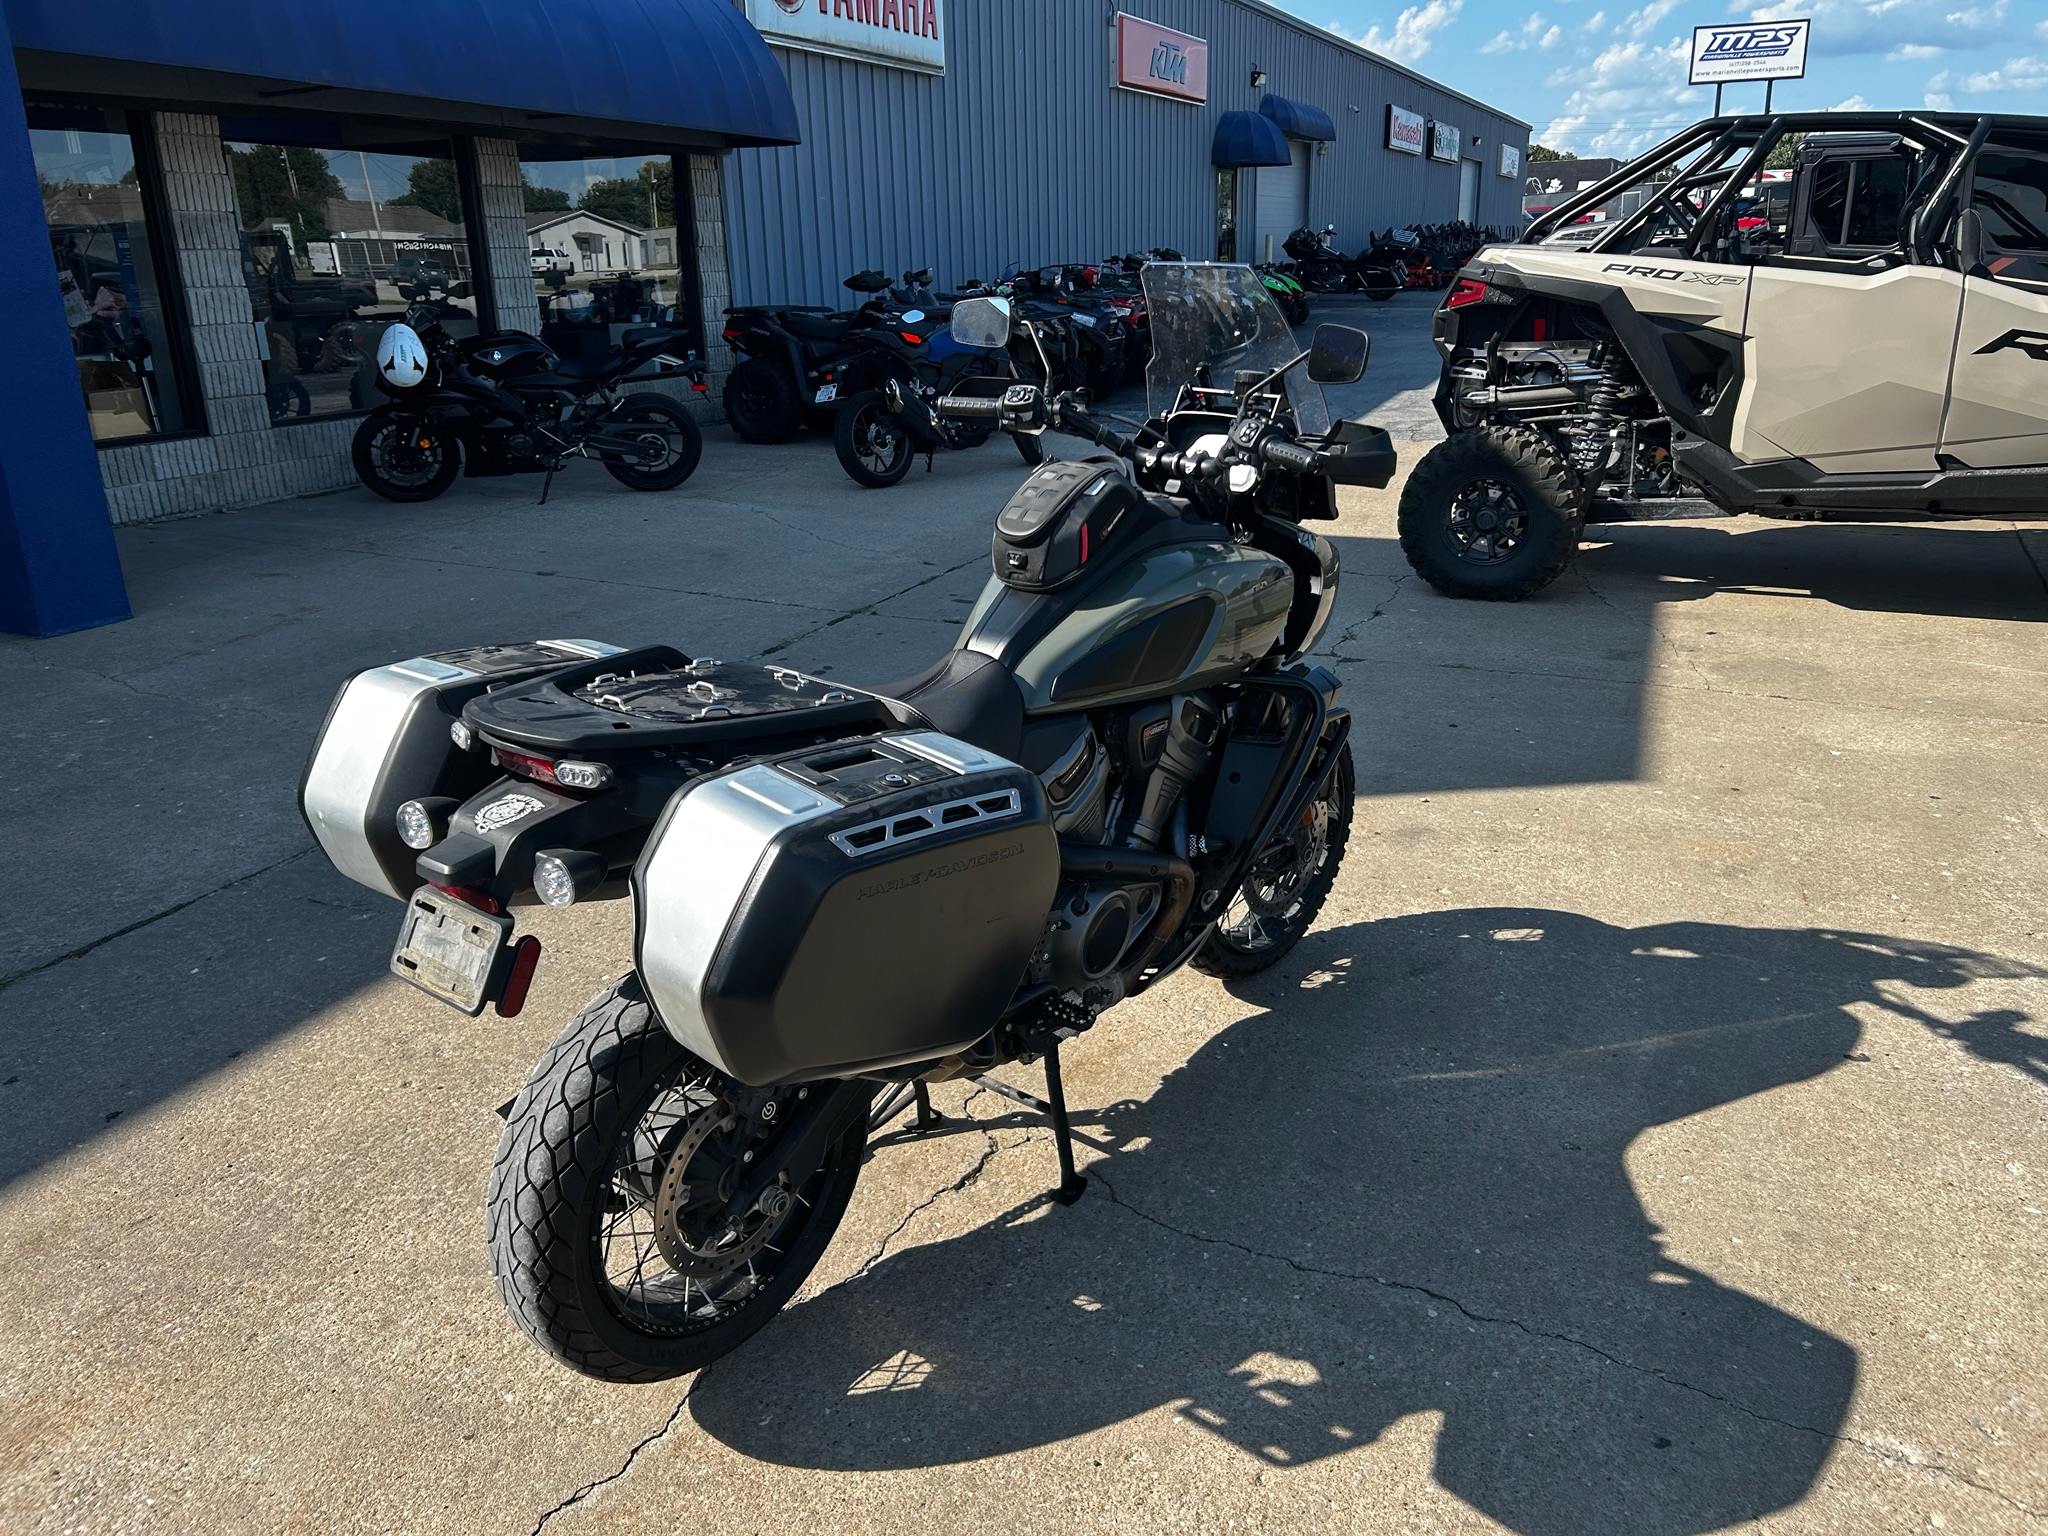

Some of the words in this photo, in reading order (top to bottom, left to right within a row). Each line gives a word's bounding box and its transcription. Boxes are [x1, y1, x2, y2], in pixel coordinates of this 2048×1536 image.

[818, 0, 938, 41] AHA
[1702, 52, 1742, 60] MARIONVILLE
[1742, 50, 1785, 58] POWERSPORTS
[1704, 27, 1801, 53] MPS
[1149, 41, 1187, 84] KTM
[1392, 114, 1423, 146] Kawasaki
[1602, 263, 1684, 281] PRO
[1682, 271, 1747, 286] XP
[857, 843, 1024, 901] HARLEY-DAVIDSON
[643, 1273, 775, 1333] HARLEY-DAVIDSON
